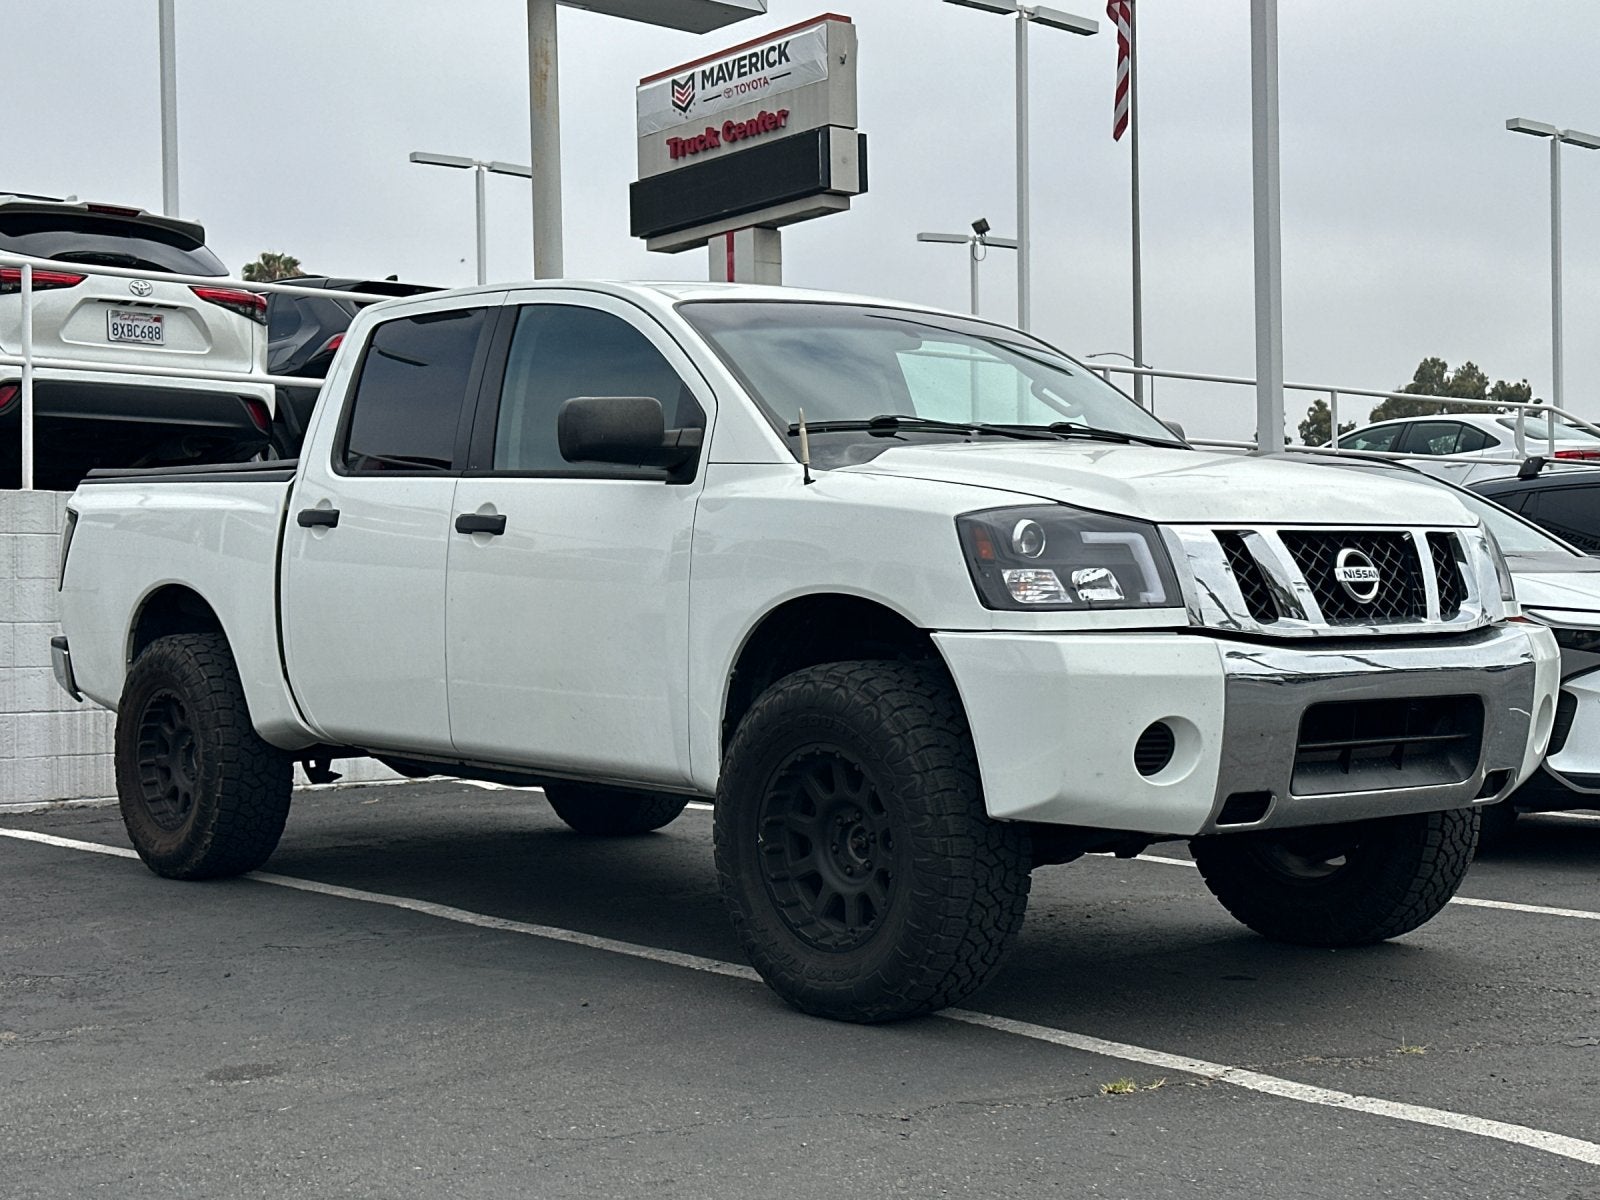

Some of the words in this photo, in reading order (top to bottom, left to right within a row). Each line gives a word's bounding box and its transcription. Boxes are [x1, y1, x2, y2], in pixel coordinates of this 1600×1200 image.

[702, 41, 790, 90] MAVERICK
[734, 76, 769, 94] TOYOTA
[666, 127, 721, 159] Truck
[722, 109, 789, 141] Center
[112, 322, 160, 339] 8XBC688
[1343, 569, 1379, 579] NISSAN
